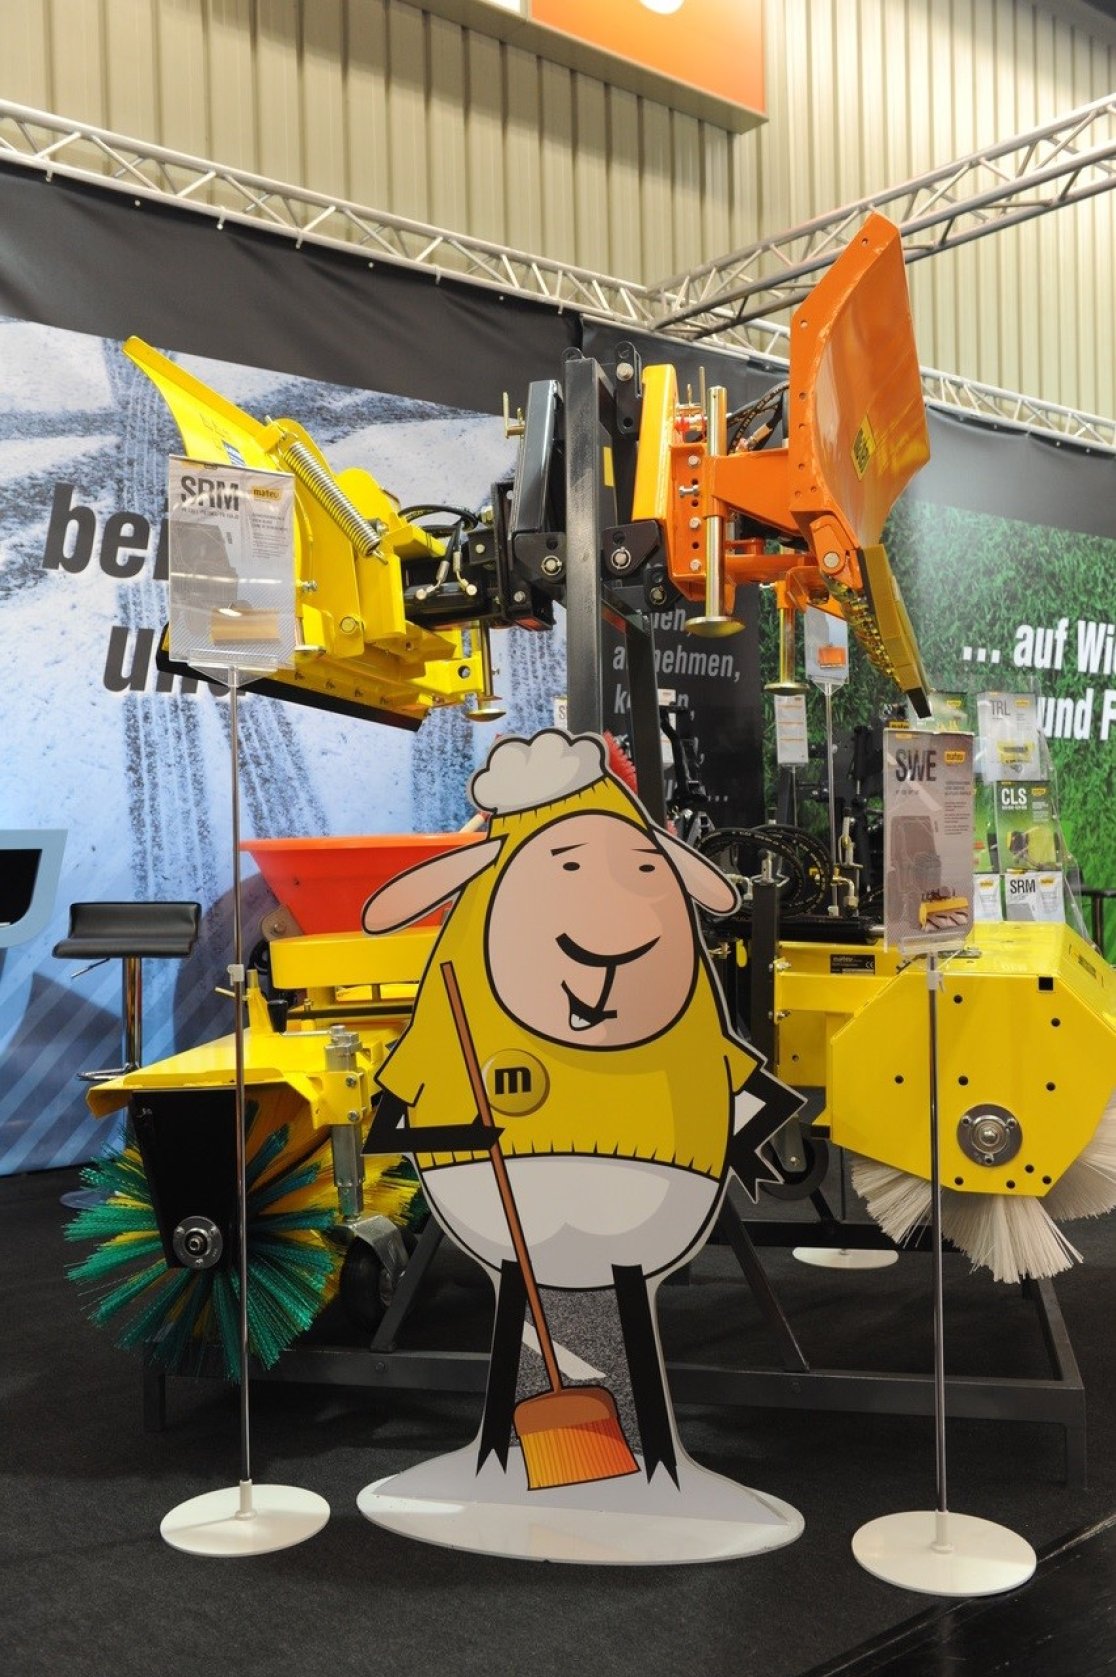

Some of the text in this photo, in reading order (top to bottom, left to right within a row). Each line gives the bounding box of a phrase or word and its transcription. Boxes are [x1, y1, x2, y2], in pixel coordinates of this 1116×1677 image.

[180, 475, 239, 511] SRM
[1013, 617, 1069, 670] auf
[1077, 619, 1116, 675] Wi
[613, 644, 740, 683] anehmen,
[990, 700, 1011, 716] TRL
[1036, 687, 1094, 740] und
[895, 748, 937, 782] SWE
[1001, 787, 1028, 806] CLS
[1009, 879, 1036, 894] SRM
[494, 1066, 532, 1095] m
